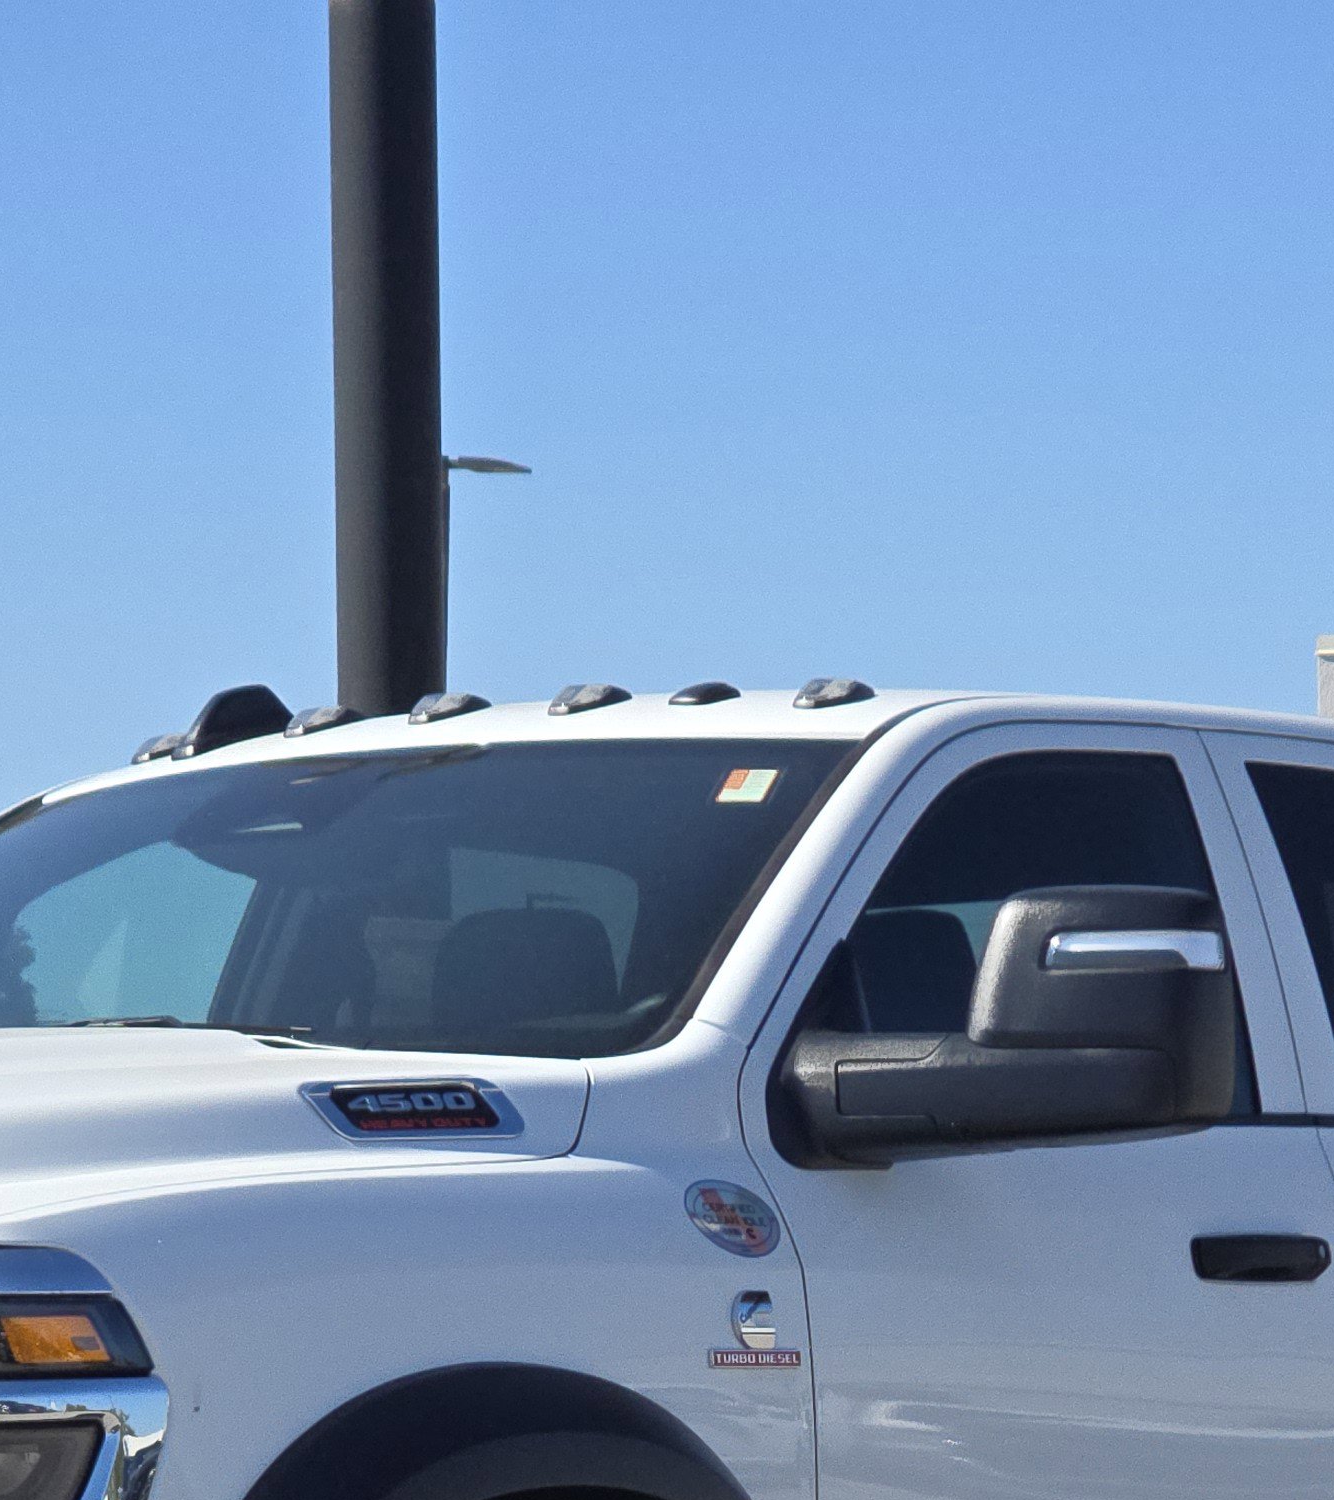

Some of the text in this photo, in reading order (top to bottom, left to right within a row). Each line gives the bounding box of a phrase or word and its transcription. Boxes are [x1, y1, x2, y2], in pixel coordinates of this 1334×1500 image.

[348, 1092, 476, 1113] 4500
[716, 1353, 799, 1364] TURBO DIESEL
